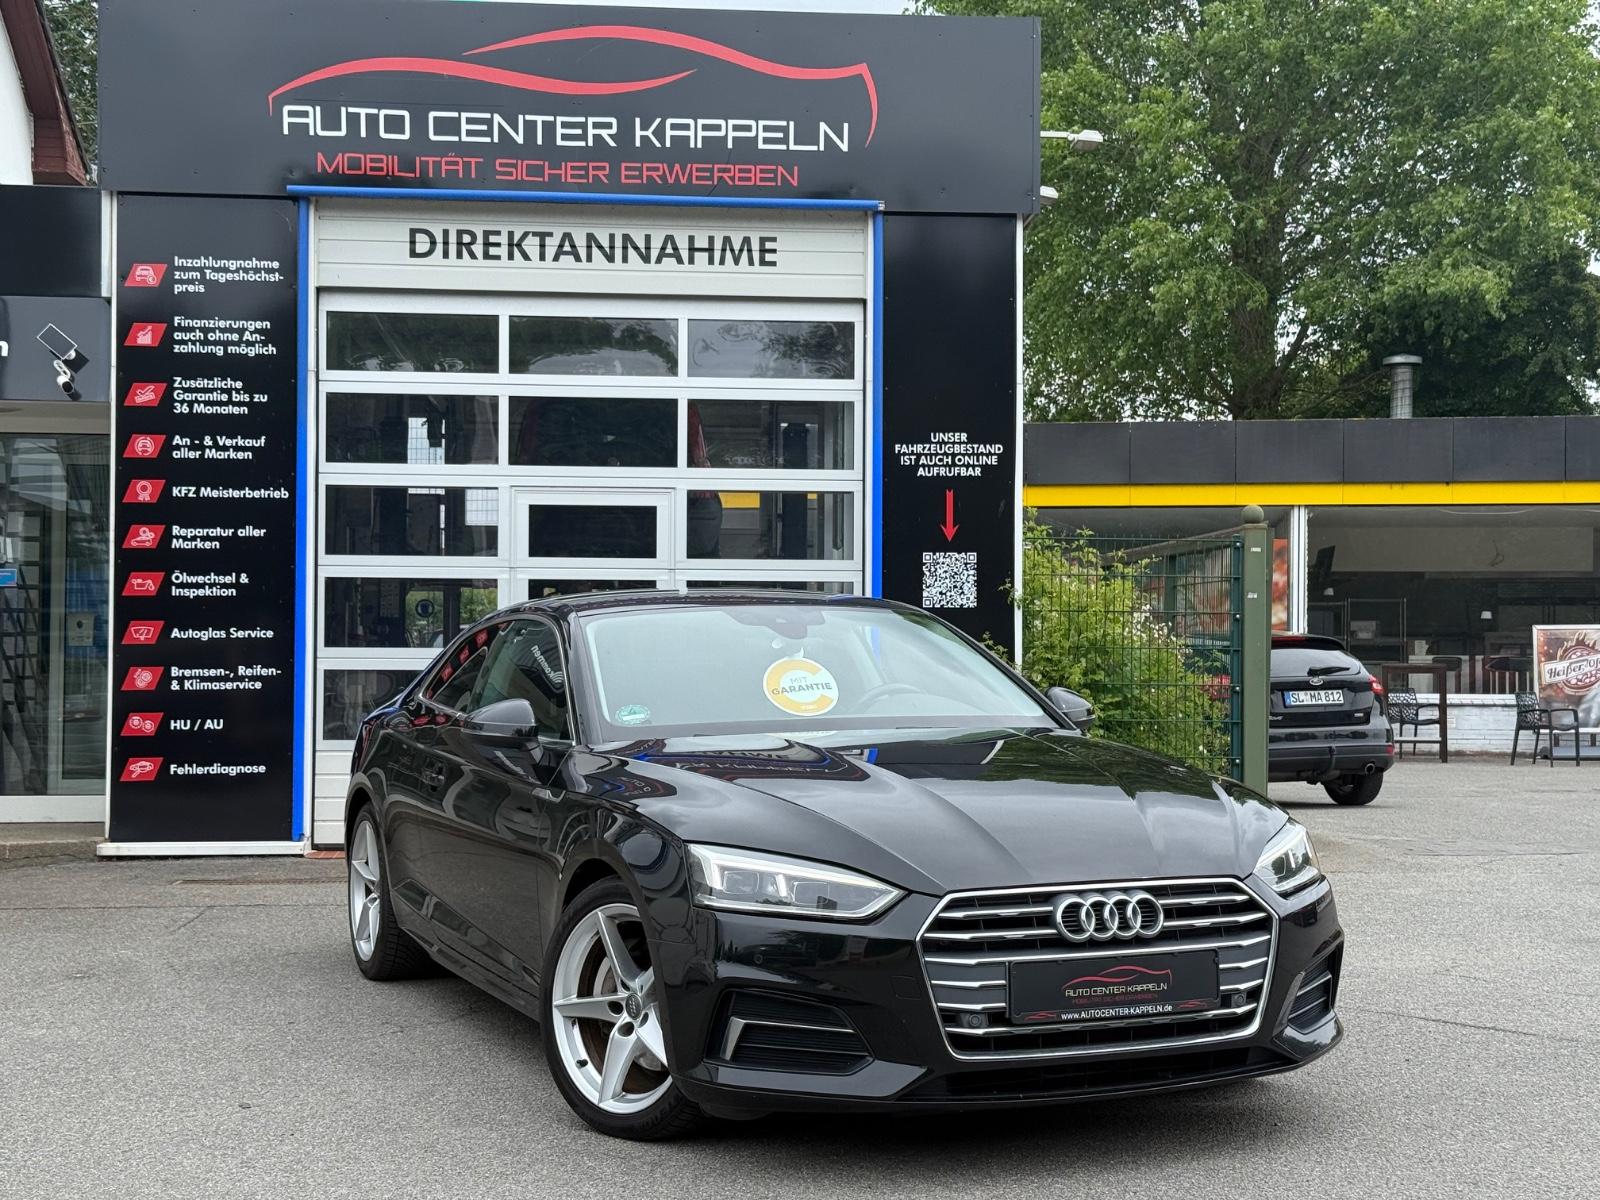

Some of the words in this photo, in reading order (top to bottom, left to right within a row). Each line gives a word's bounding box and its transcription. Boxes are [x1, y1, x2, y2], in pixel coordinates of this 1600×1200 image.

[282, 105, 410, 140] AUTO
[428, 111, 617, 147] CENTER
[635, 117, 849, 152] KAPPELN
[317, 151, 484, 178] MOBILITÄT
[496, 158, 609, 183] SICHER
[621, 162, 799, 187] ERWERBEN
[409, 228, 777, 266] DIREKTANNAHME
[174, 256, 280, 270] Inzahlungnahme
[174, 271, 200, 279] zum
[204, 268, 284, 283] Tageshöchst-
[174, 282, 205, 294] preis
[174, 317, 270, 331] Finanzierungen
[174, 329, 203, 340] auch
[208, 330, 239, 341] ohne
[243, 330, 265, 341] An-
[174, 342, 223, 356] zahlung
[228, 344, 276, 356] möglich
[174, 377, 243, 389] Zusätzliche
[174, 390, 228, 402] Garantie
[232, 391, 249, 401] bis
[254, 394, 267, 402] zu
[174, 403, 189, 413] 36
[193, 403, 248, 414] Monaten
[173, 435, 190, 445] An
[204, 436, 212, 446] &
[217, 436, 266, 448] Verkauf
[931, 433, 967, 442] UNSER
[173, 448, 201, 458] aller
[205, 448, 252, 459] Marken
[895, 444, 1003, 454] FAHRZEUGBESTAND
[901, 456, 916, 465] IST
[919, 455, 951, 465] AUCH
[955, 456, 997, 465] ONLINE
[917, 467, 981, 476] AUFRUFBAR
[173, 487, 196, 497] KFZ
[200, 487, 289, 498] Meisterbetrieb
[172, 526, 234, 540] Reparatur
[238, 526, 266, 536] aller
[172, 537, 219, 549] Marken
[172, 570, 235, 583] Ölwechsel
[240, 573, 248, 583] &
[172, 586, 236, 598] Inspektion
[171, 628, 226, 640] Autoglas
[230, 627, 273, 638] Service
[171, 667, 233, 679] Bremsen-,
[238, 665, 281, 676] Reifen-
[171, 680, 180, 690] &
[185, 677, 262, 690] Klimaservice
[771, 682, 832, 695] GARANTIE
[1290, 692, 1304, 703] SL
[1310, 692, 1323, 702] MA
[1325, 691, 1342, 702] 812
[171, 720, 190, 730] HU
[204, 719, 223, 729] AU
[171, 763, 266, 776] Fehlerdiagnose
[1065, 988, 1090, 997] AUTO
[1091, 985, 1126, 996] CENTER
[1127, 982, 1168, 993] KAPPELN
[1061, 1003, 1173, 1020] www.AUTOCENTER-KAPPELN.de
